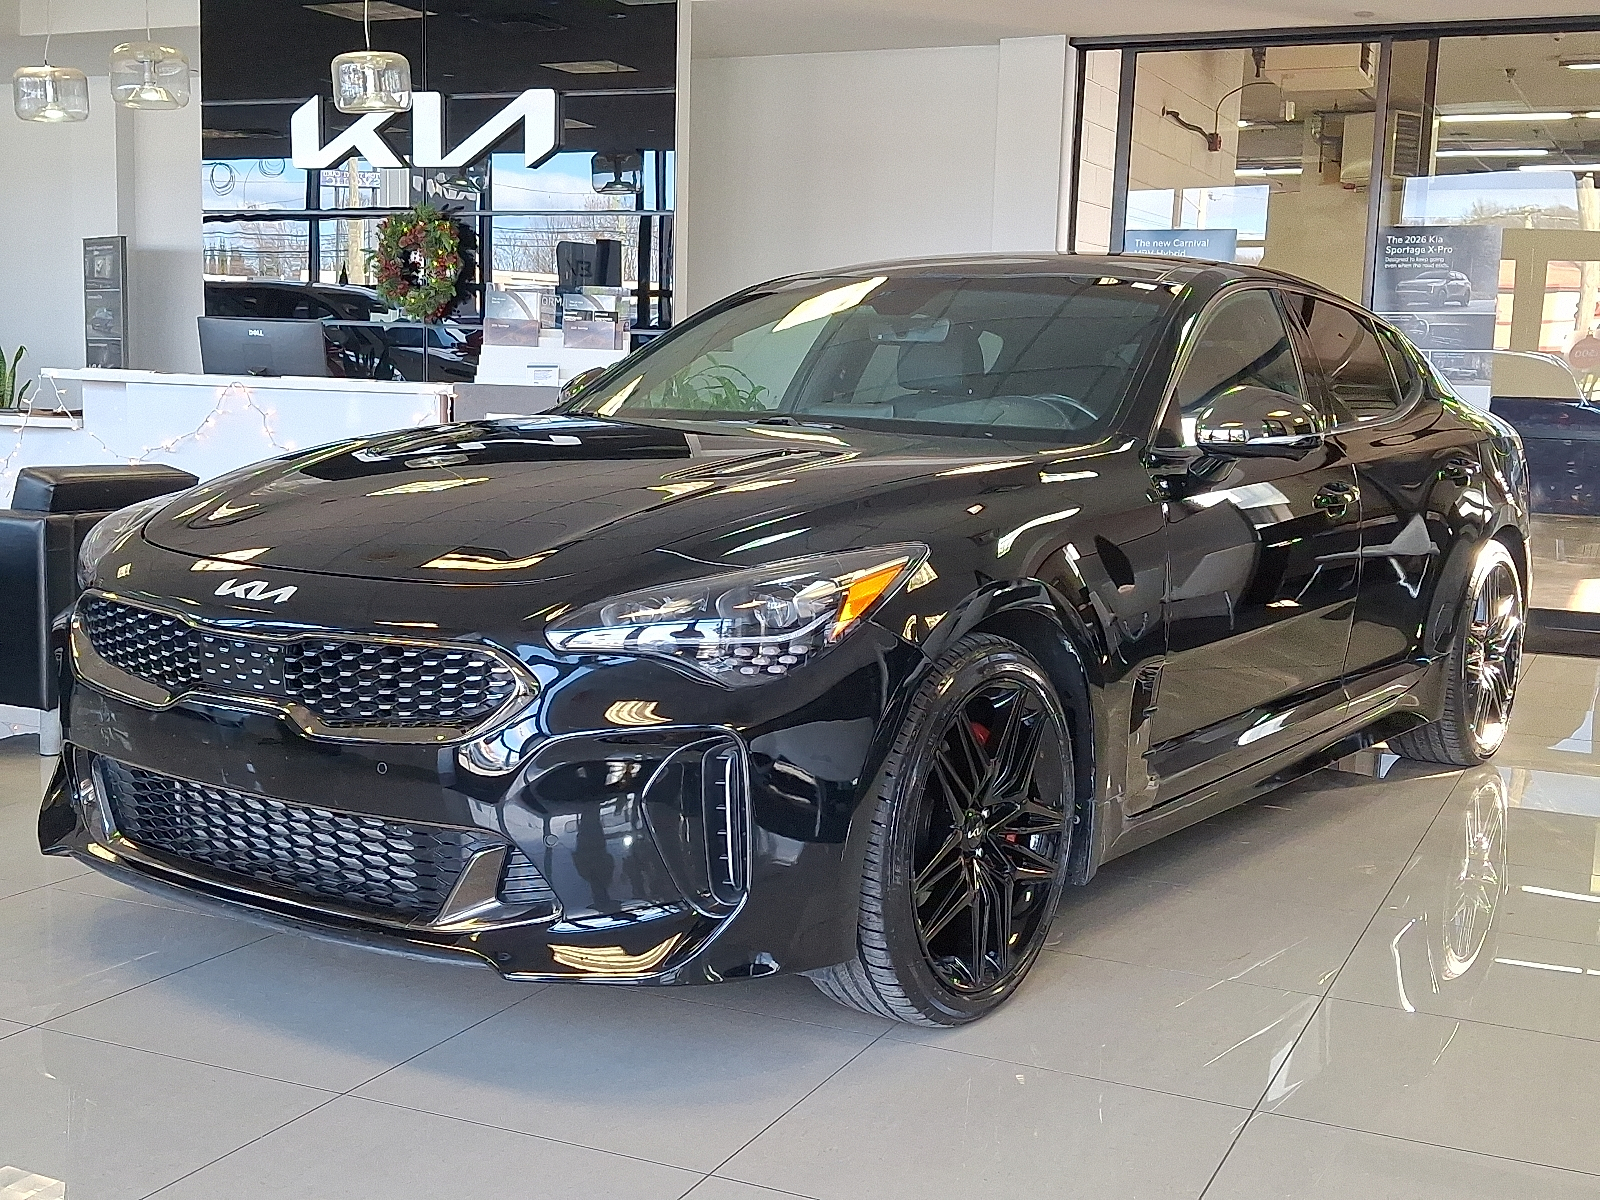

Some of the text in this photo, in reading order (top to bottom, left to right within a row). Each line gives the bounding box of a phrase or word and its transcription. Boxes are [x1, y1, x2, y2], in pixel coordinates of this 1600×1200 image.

[291, 88, 556, 168] KIA
[1135, 238, 1150, 247] The
[1173, 238, 1209, 247] Carnival
[1386, 235, 1444, 244] The 2026 Kia
[1386, 246, 1453, 255] Sportage X-Pro
[248, 329, 264, 337] DELL
[214, 578, 298, 604] KIA
